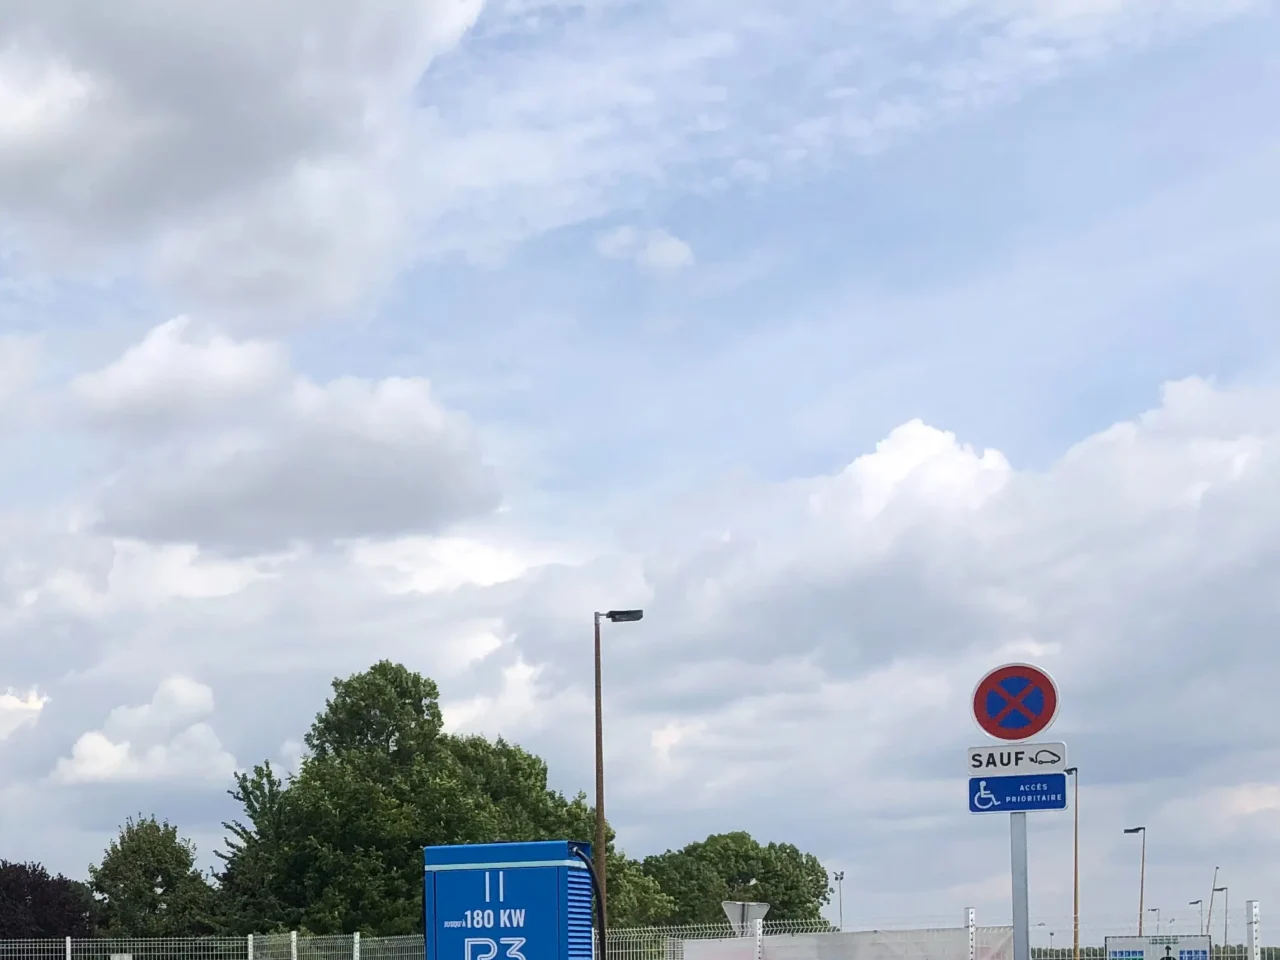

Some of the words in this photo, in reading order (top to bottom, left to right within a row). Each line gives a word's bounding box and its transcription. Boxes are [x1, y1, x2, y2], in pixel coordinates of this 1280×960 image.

[971, 751, 1025, 768] SAUF
[1005, 793, 1062, 803] PRIORITAIRE
[464, 909, 494, 928] 180
[500, 908, 525, 928] KW
